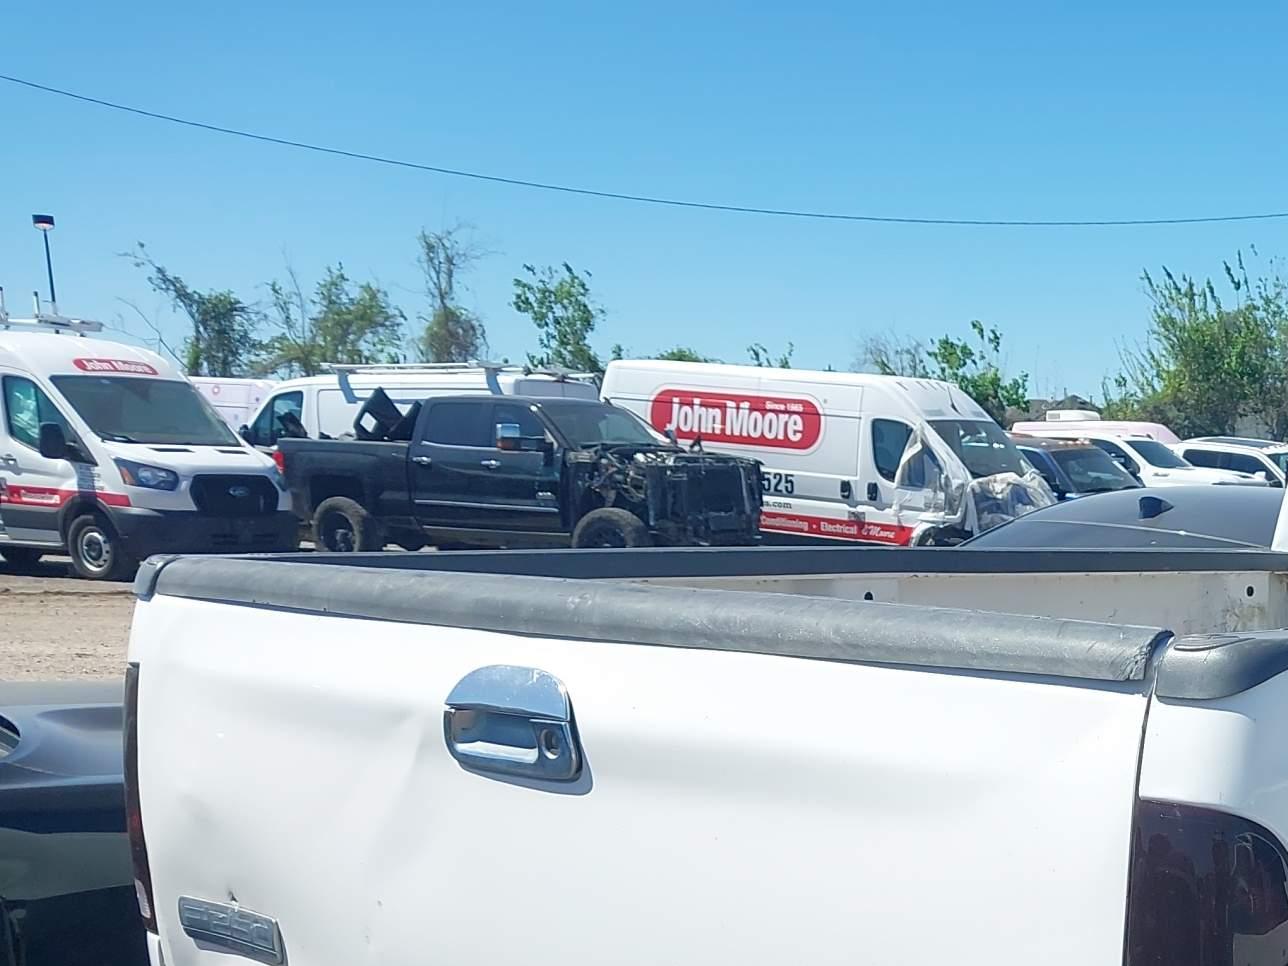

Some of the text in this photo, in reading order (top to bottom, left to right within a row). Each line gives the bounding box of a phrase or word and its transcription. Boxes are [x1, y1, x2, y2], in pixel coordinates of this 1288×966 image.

[81, 359, 153, 374] John Moore
[765, 400, 786, 411] Since
[665, 397, 804, 442] John Moore
[820, 521, 857, 535] Electrical
